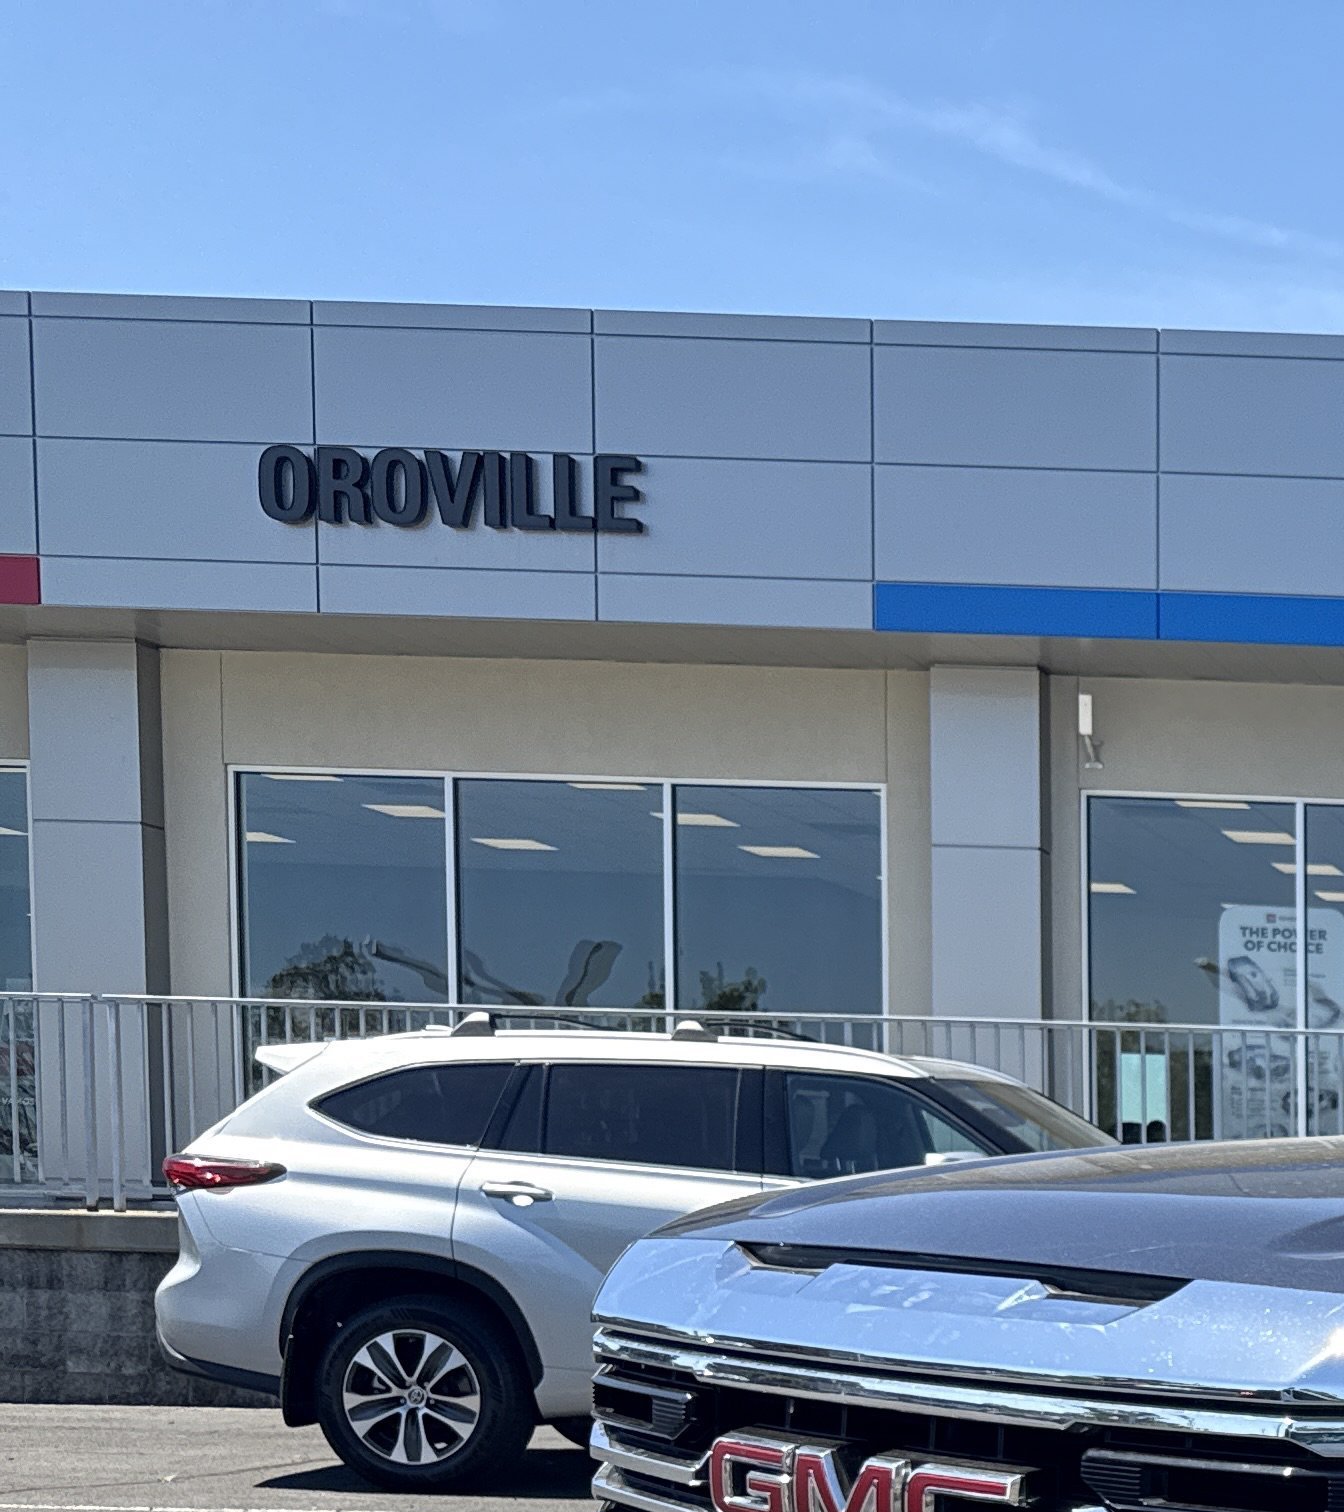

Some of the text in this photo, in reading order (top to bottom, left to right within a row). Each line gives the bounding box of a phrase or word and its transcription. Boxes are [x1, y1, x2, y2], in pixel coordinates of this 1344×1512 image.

[258, 444, 644, 534] OROVILLE
[1240, 927, 1327, 941] THE POER
[1244, 940, 1324, 954] OF CHOCE
